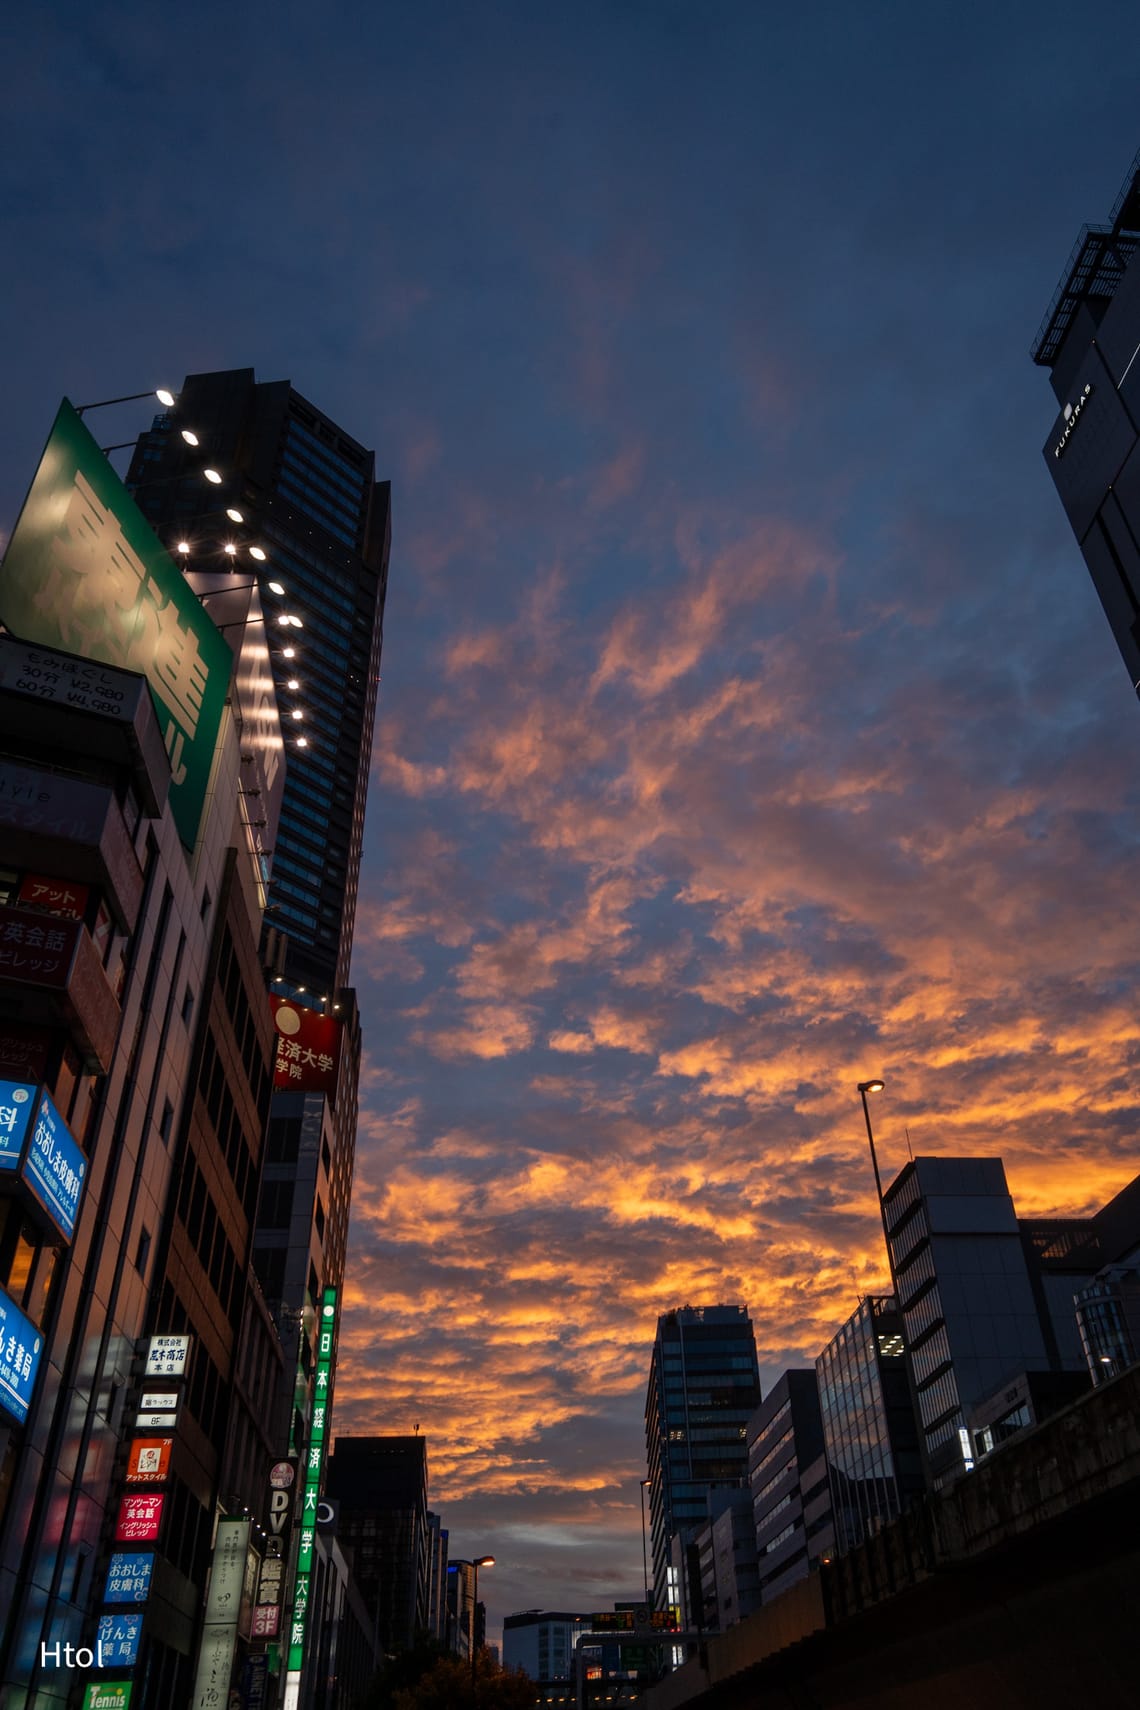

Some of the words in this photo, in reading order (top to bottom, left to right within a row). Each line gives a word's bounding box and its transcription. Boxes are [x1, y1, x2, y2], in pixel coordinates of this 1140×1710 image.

[22, 665, 60, 683] 30分
[28, 653, 113, 684] もみほぐし
[16, 679, 56, 698] 60分
[32, 884, 76, 904] アット
[0, 921, 67, 952] 英会話
[123, 1497, 162, 1508] マンツーマン
[126, 1508, 155, 1519] 英会話
[109, 1564, 152, 1577] おおしま
[109, 1578, 145, 1592] 皮膚科
[256, 1608, 276, 1619] 受付
[101, 1627, 138, 1641] げんき
[255, 1620, 275, 1634] 3F
[90, 1686, 126, 1708] Tennis
